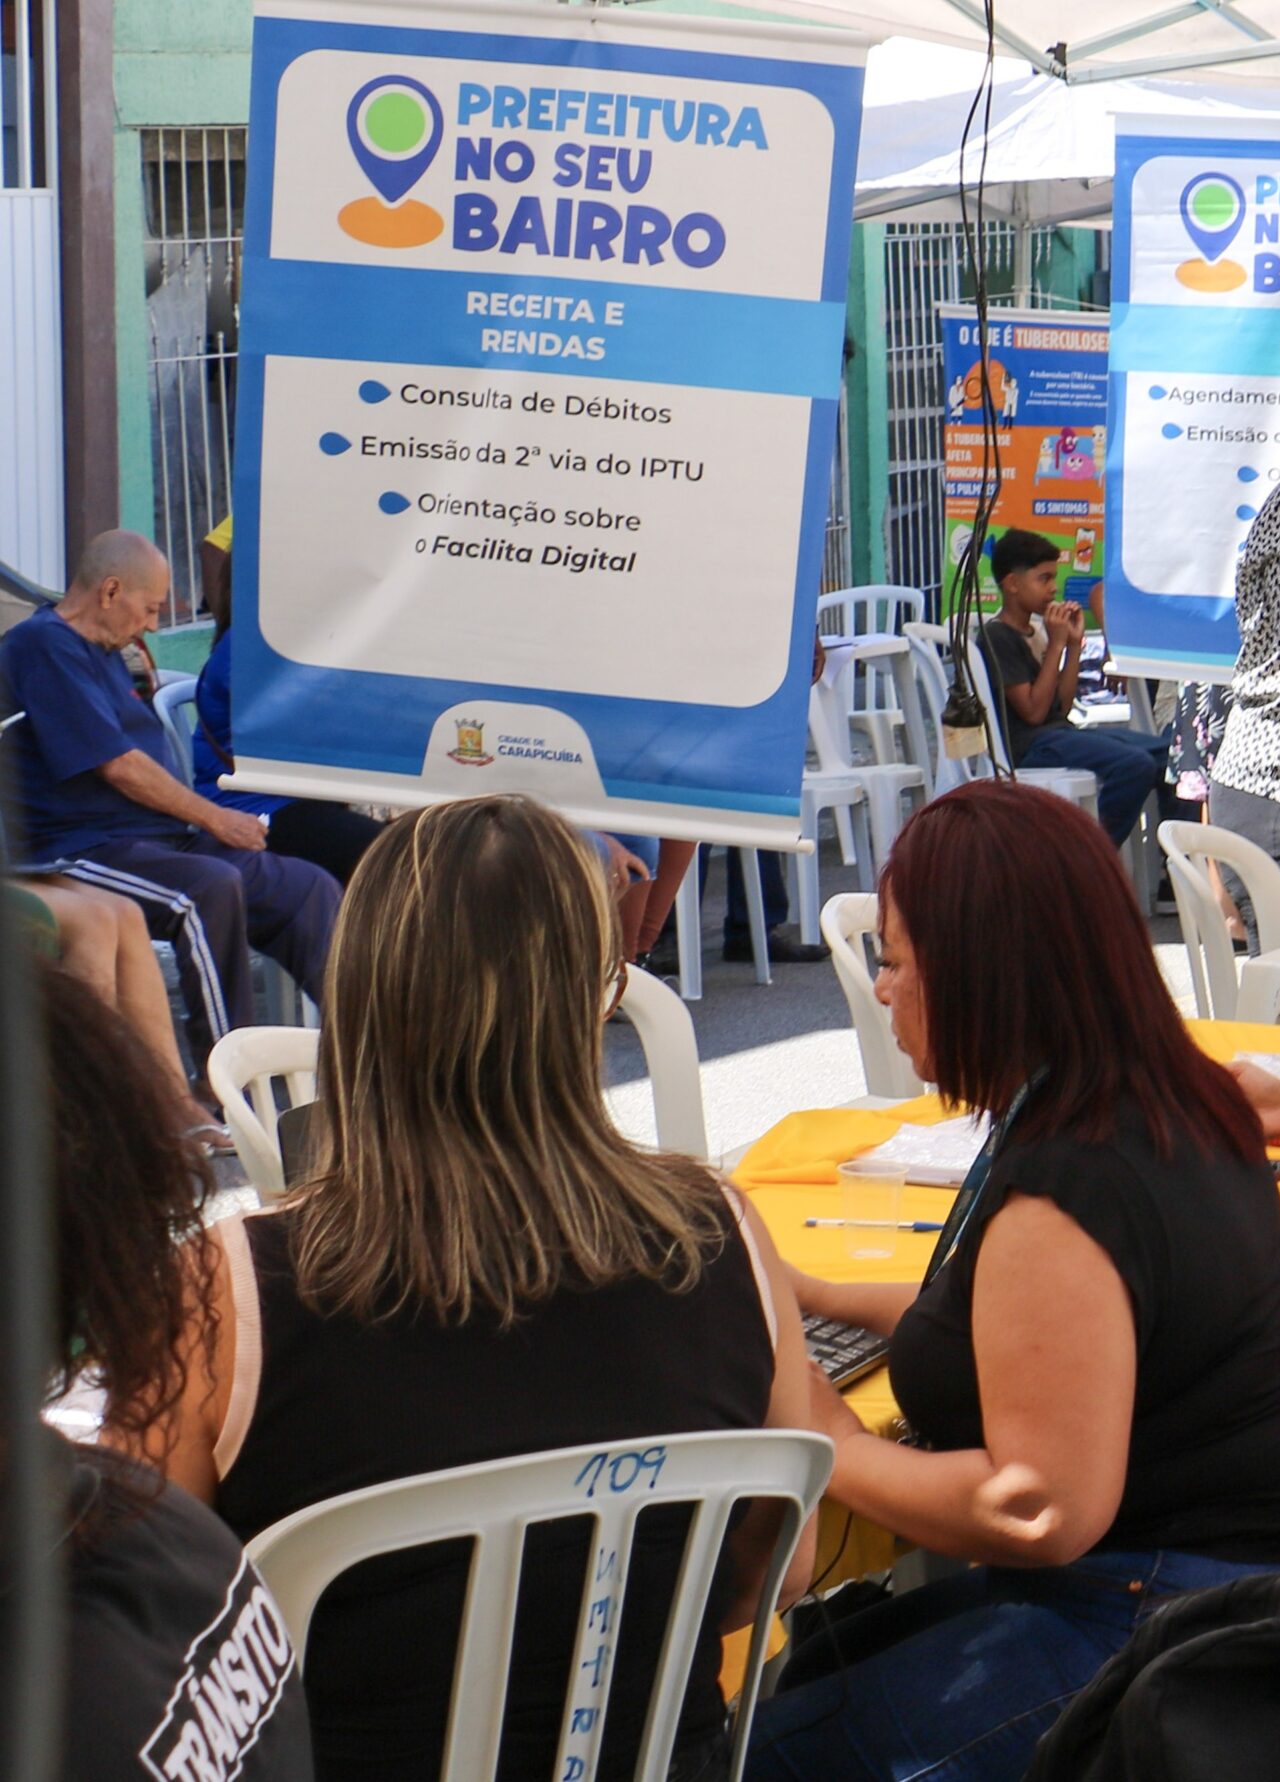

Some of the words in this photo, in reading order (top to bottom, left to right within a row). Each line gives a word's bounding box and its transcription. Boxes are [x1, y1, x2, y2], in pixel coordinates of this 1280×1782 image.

[457, 82, 769, 150] PREFEITURA
[455, 137, 535, 183] NO
[552, 145, 653, 194] SEU
[452, 192, 726, 269] BAIRRO
[466, 291, 595, 324] RECEITA
[605, 301, 625, 326] E
[480, 328, 606, 361] RENDAS
[959, 326, 969, 345] O
[1003, 324, 1013, 347] É
[400, 384, 512, 410] Consulta
[521, 391, 555, 413] de
[565, 395, 672, 424] Débitos
[1187, 425, 1267, 443] Emissão
[360, 436, 471, 461] Emissão
[476, 443, 506, 465] da
[515, 446, 541, 466] 2ª
[549, 449, 587, 471] via
[596, 454, 631, 476] do
[640, 457, 704, 482] IPTU
[418, 493, 556, 527] Orientação
[564, 507, 641, 531] sobre
[415, 538, 426, 553] o
[432, 536, 533, 563] Facilita
[541, 545, 636, 574] Digital
[498, 744, 583, 763] CARAPICUÍBA
[163, 1585, 288, 1782] TRÂNSITO
